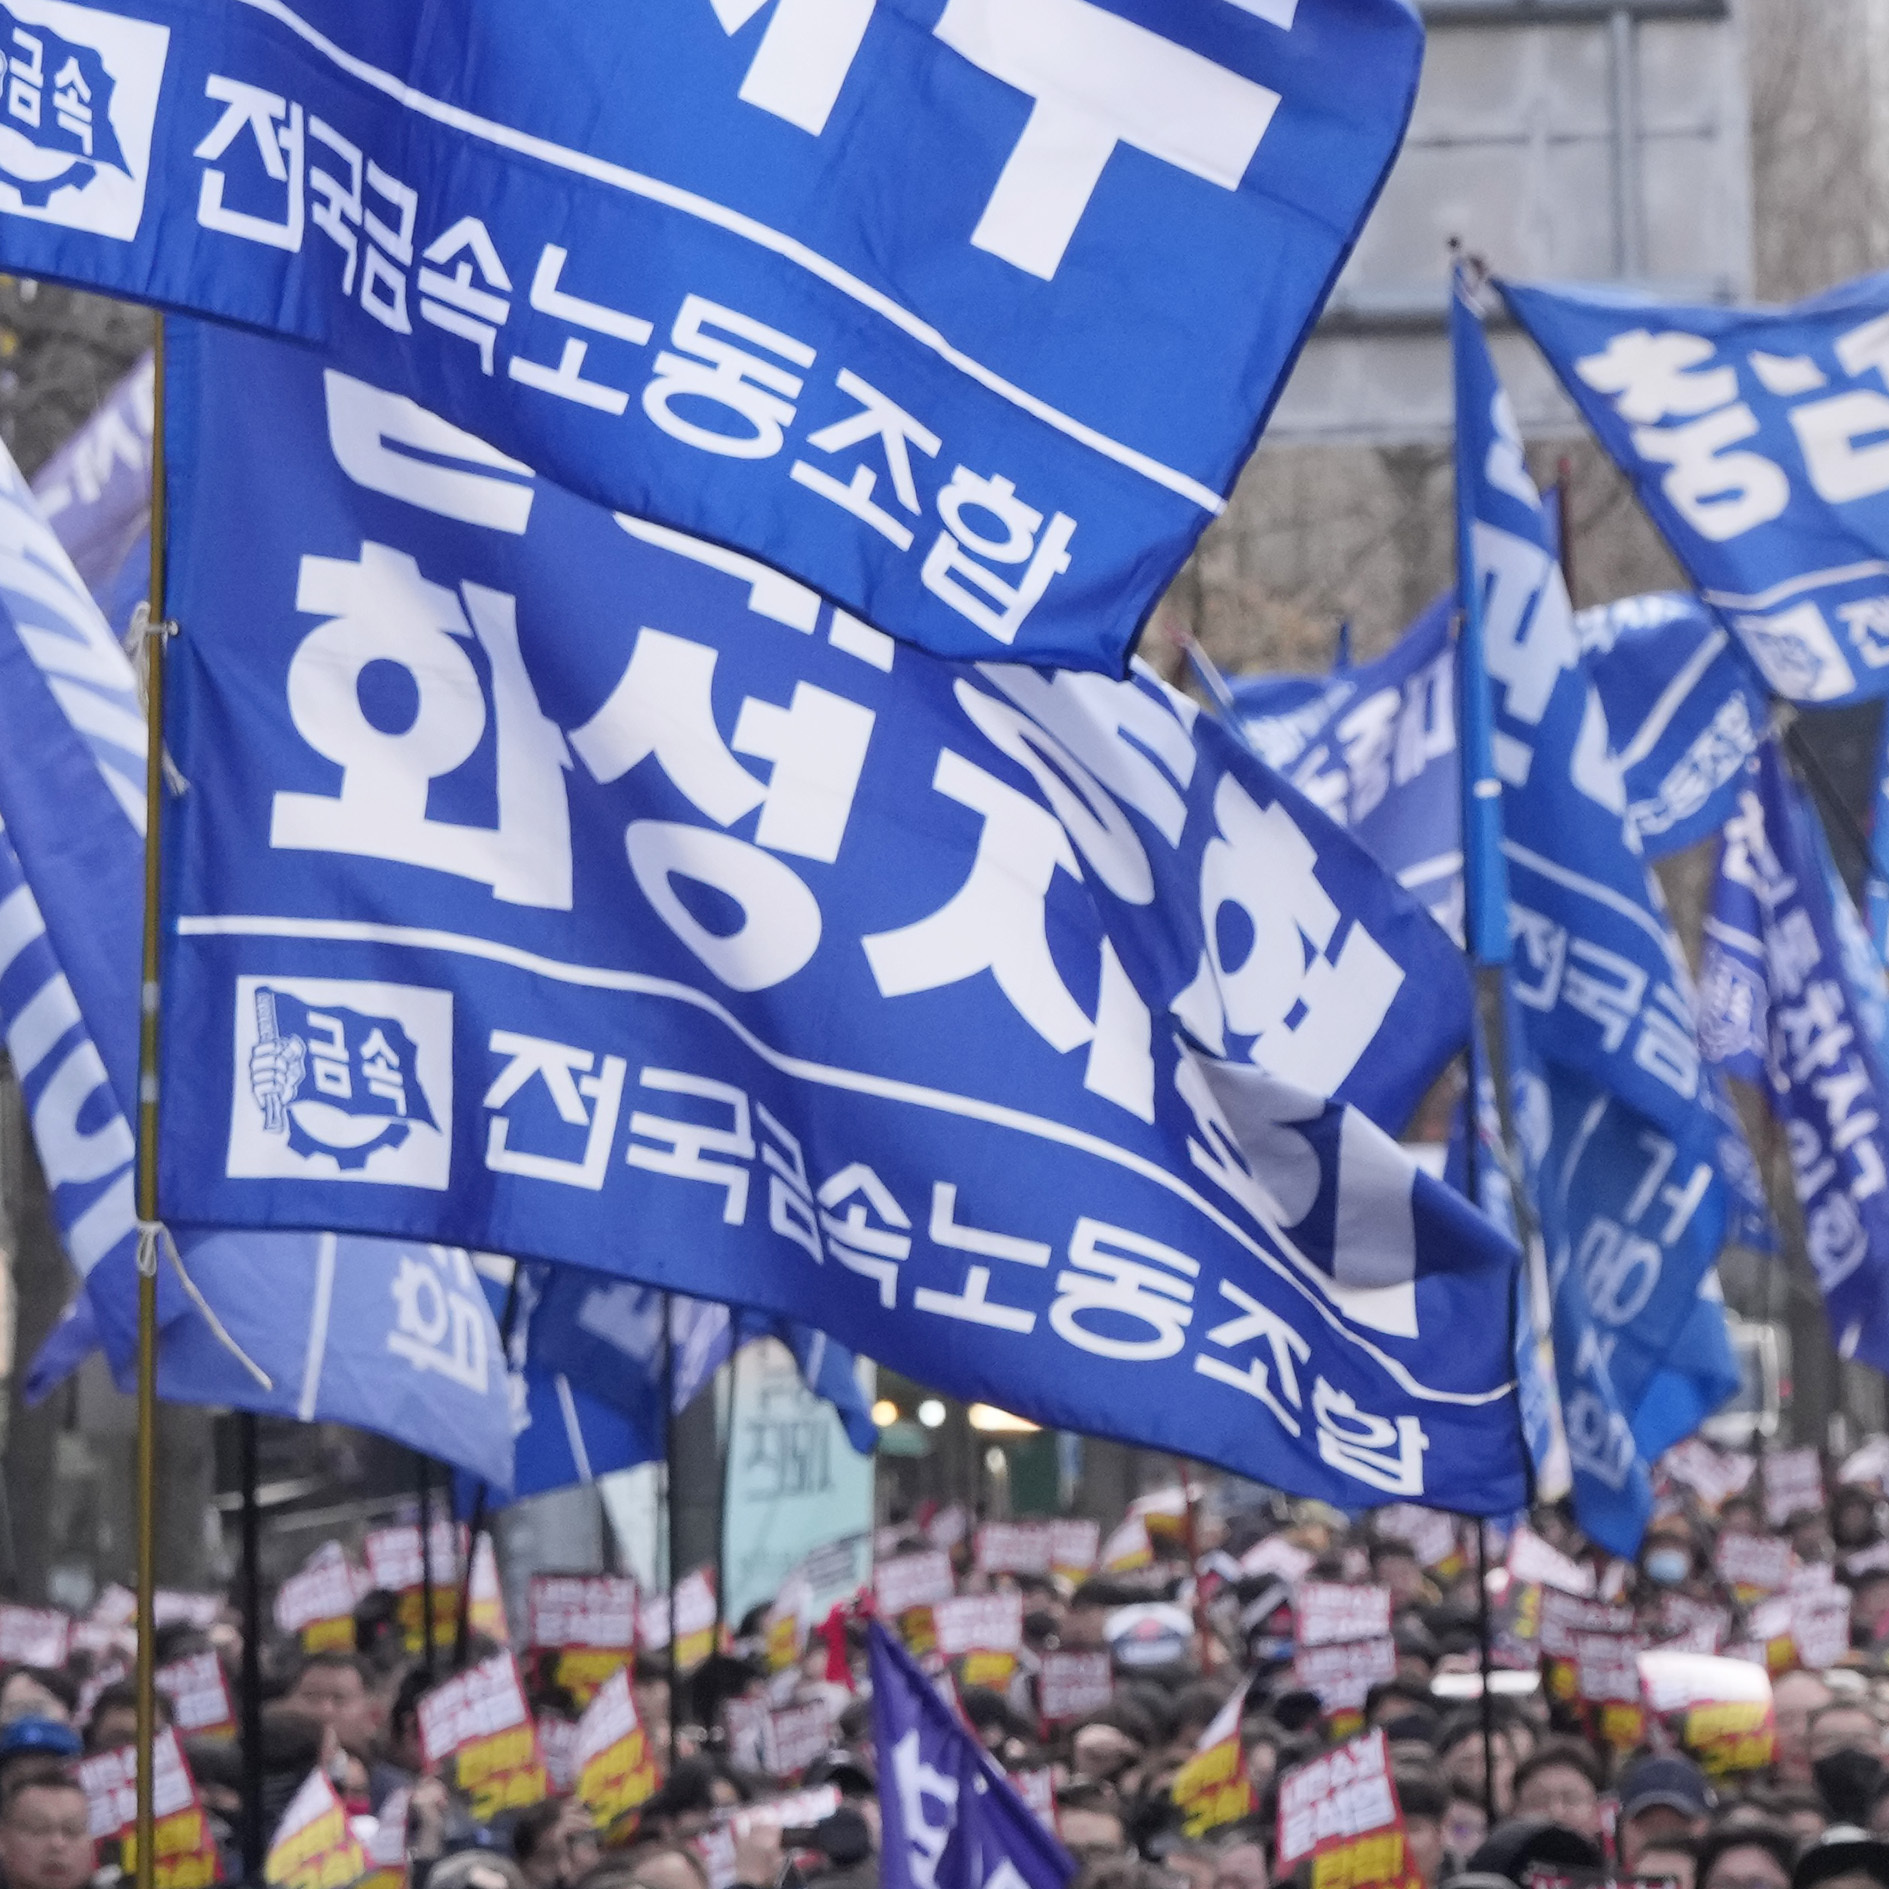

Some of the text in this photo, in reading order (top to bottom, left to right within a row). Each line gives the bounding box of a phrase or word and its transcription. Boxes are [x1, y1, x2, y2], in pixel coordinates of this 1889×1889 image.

[195, 73, 1077, 645] 전국금속노동조합
[307, 1010, 408, 1117] 금속
[484, 1030, 1427, 1497] 전국금속노동조합
